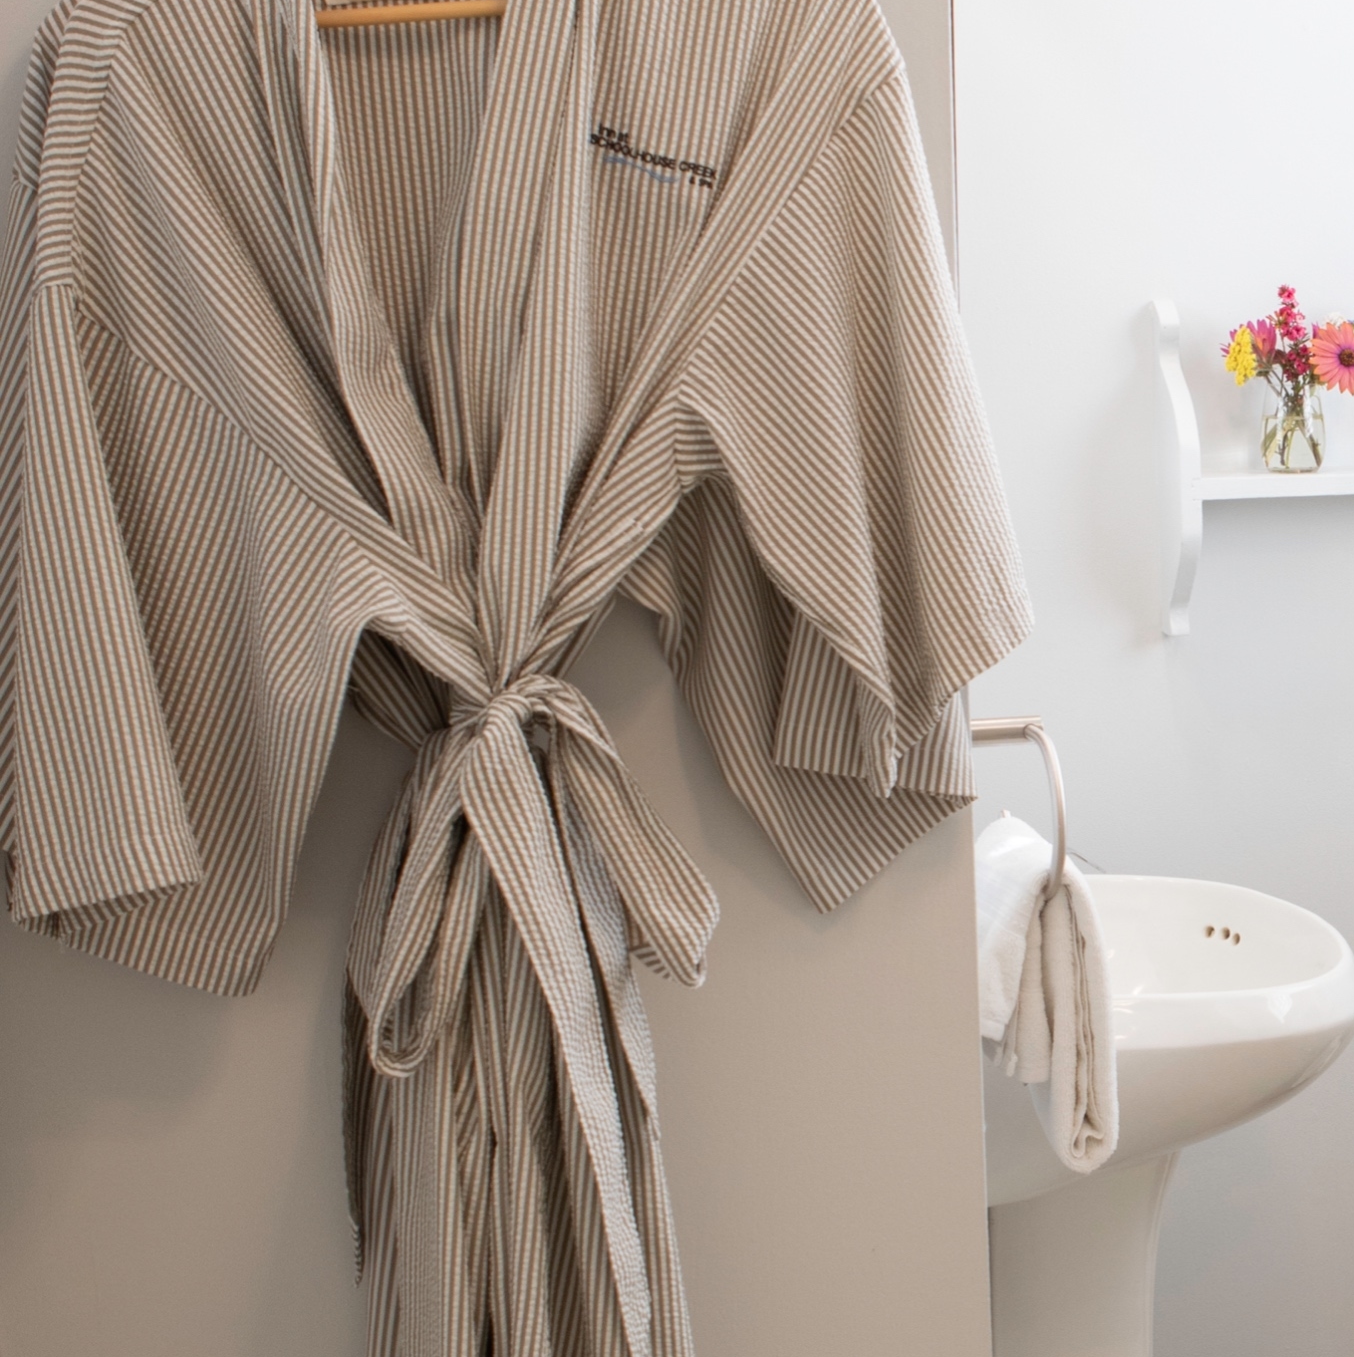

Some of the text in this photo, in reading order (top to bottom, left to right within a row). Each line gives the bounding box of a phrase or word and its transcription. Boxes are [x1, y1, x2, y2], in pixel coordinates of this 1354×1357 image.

[598, 123, 629, 144] Inn at
[590, 133, 717, 180] SCHOOLHOUSE CREEK
